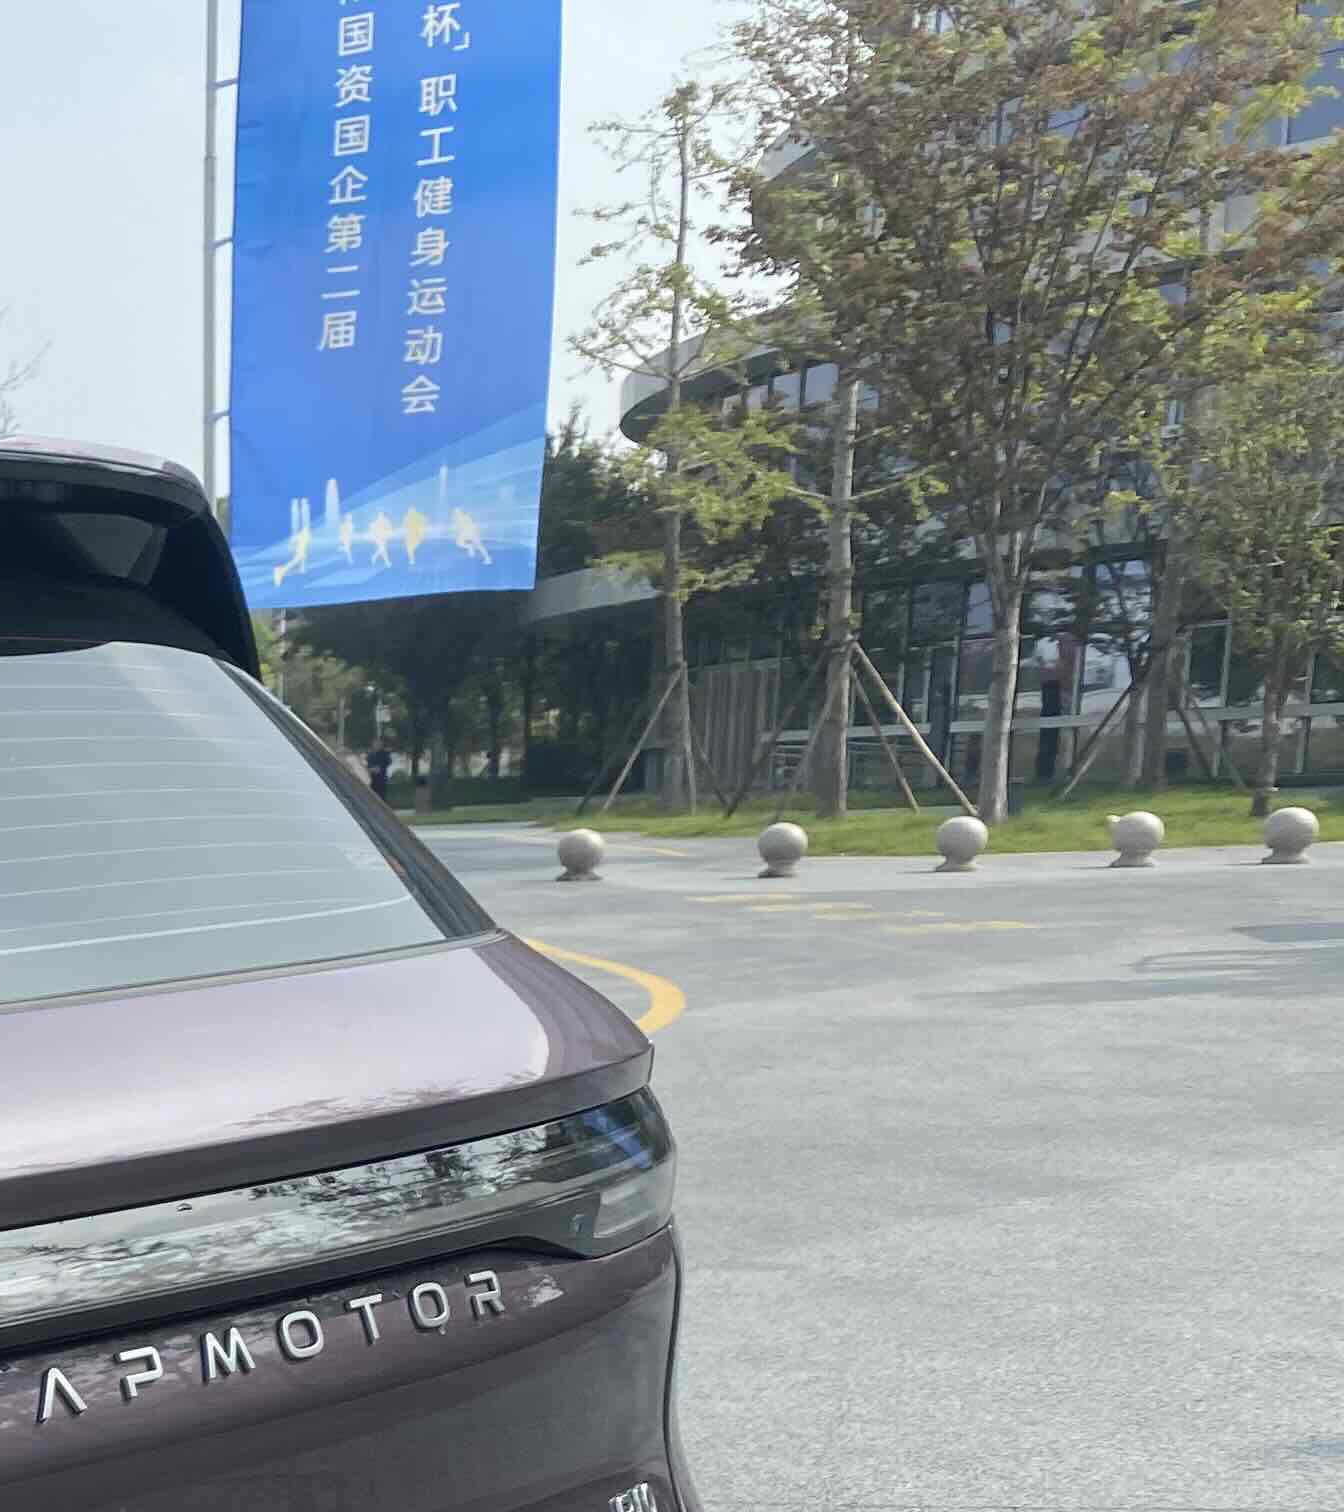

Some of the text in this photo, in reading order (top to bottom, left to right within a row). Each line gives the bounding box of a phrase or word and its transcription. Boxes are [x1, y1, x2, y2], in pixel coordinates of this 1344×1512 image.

[318, 0, 375, 352] 国资国企第二届
